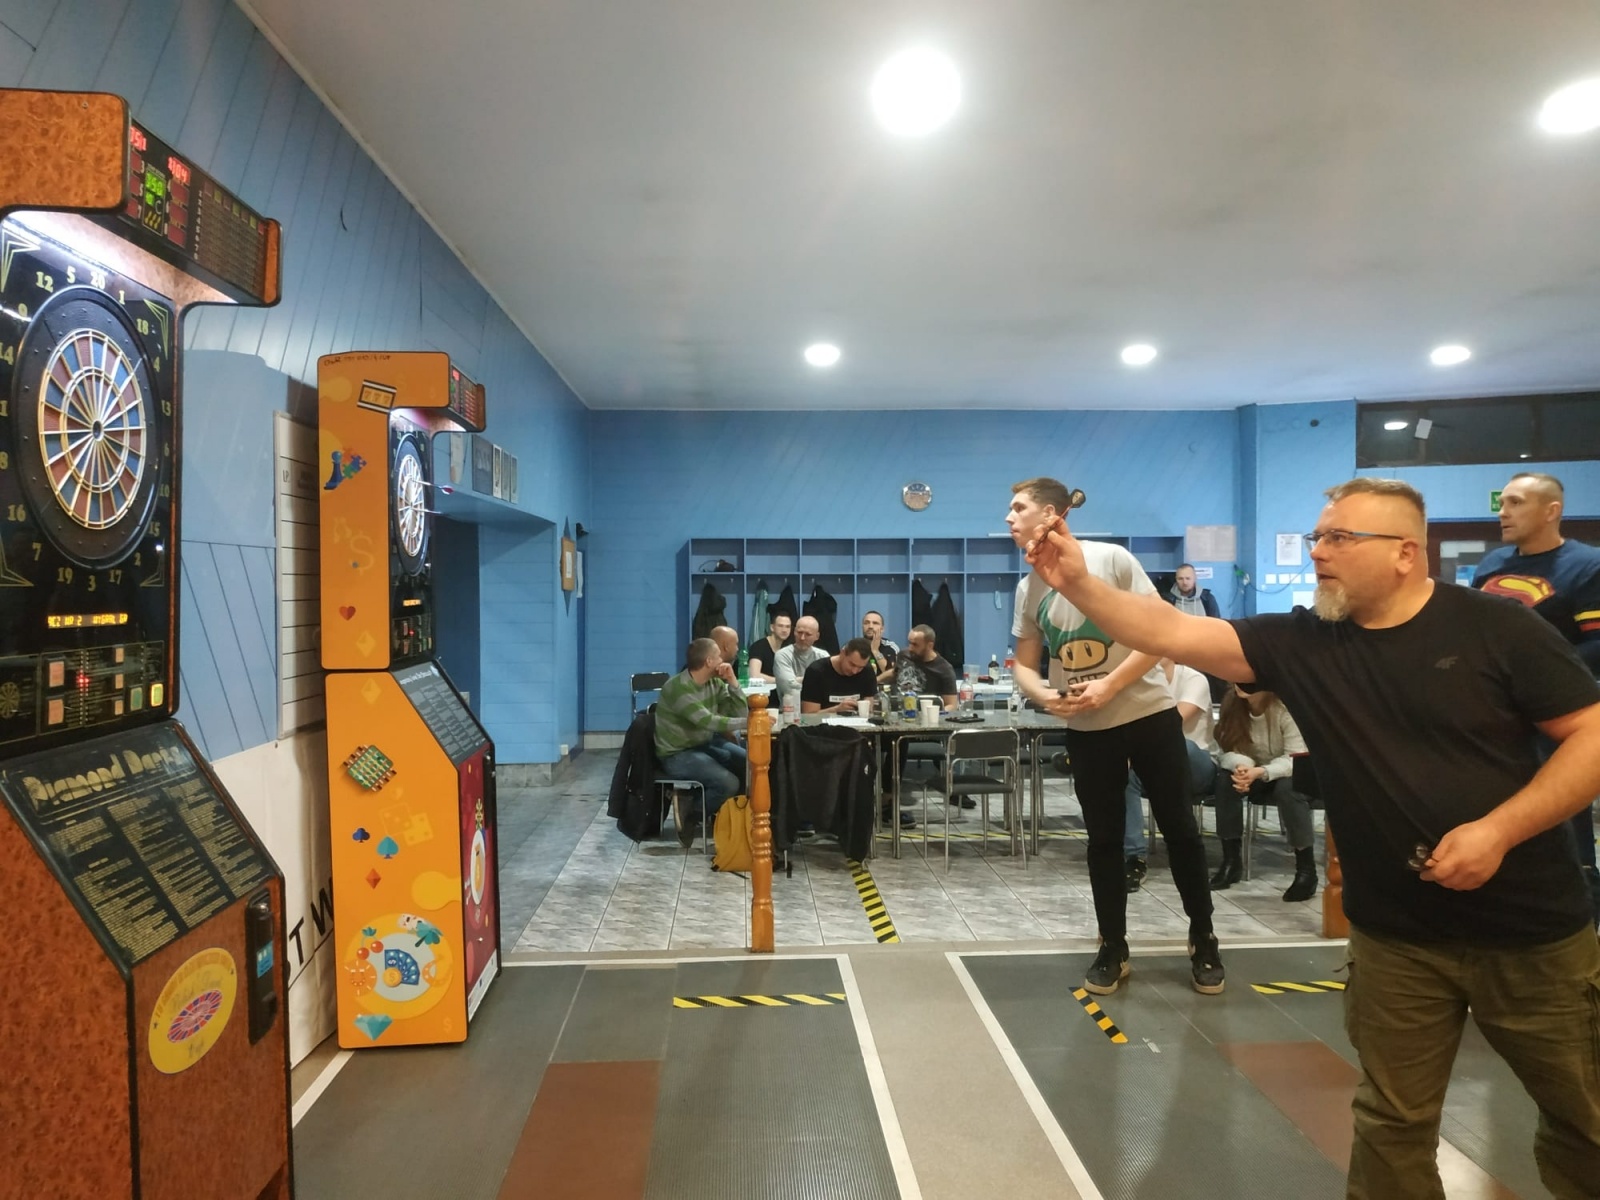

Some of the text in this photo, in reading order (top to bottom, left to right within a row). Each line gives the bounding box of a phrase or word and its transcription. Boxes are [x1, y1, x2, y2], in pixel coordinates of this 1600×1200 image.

[36, 272, 54, 292] 12
[66, 266, 75, 283] 5
[90, 272, 106, 289] 20
[118, 290, 125, 305] 1
[136, 318, 149, 336] 18
[154, 357, 161, 372] 4
[161, 400, 171, 416] 13
[8, 504, 26, 521] 16
[149, 522, 160, 537] 15
[32, 542, 42, 561] 7
[134, 553, 141, 566] 2
[57, 568, 73, 584] 19
[88, 575, 96, 591] 3
[109, 569, 122, 585] 17
[22, 753, 126, 812] Diamond
